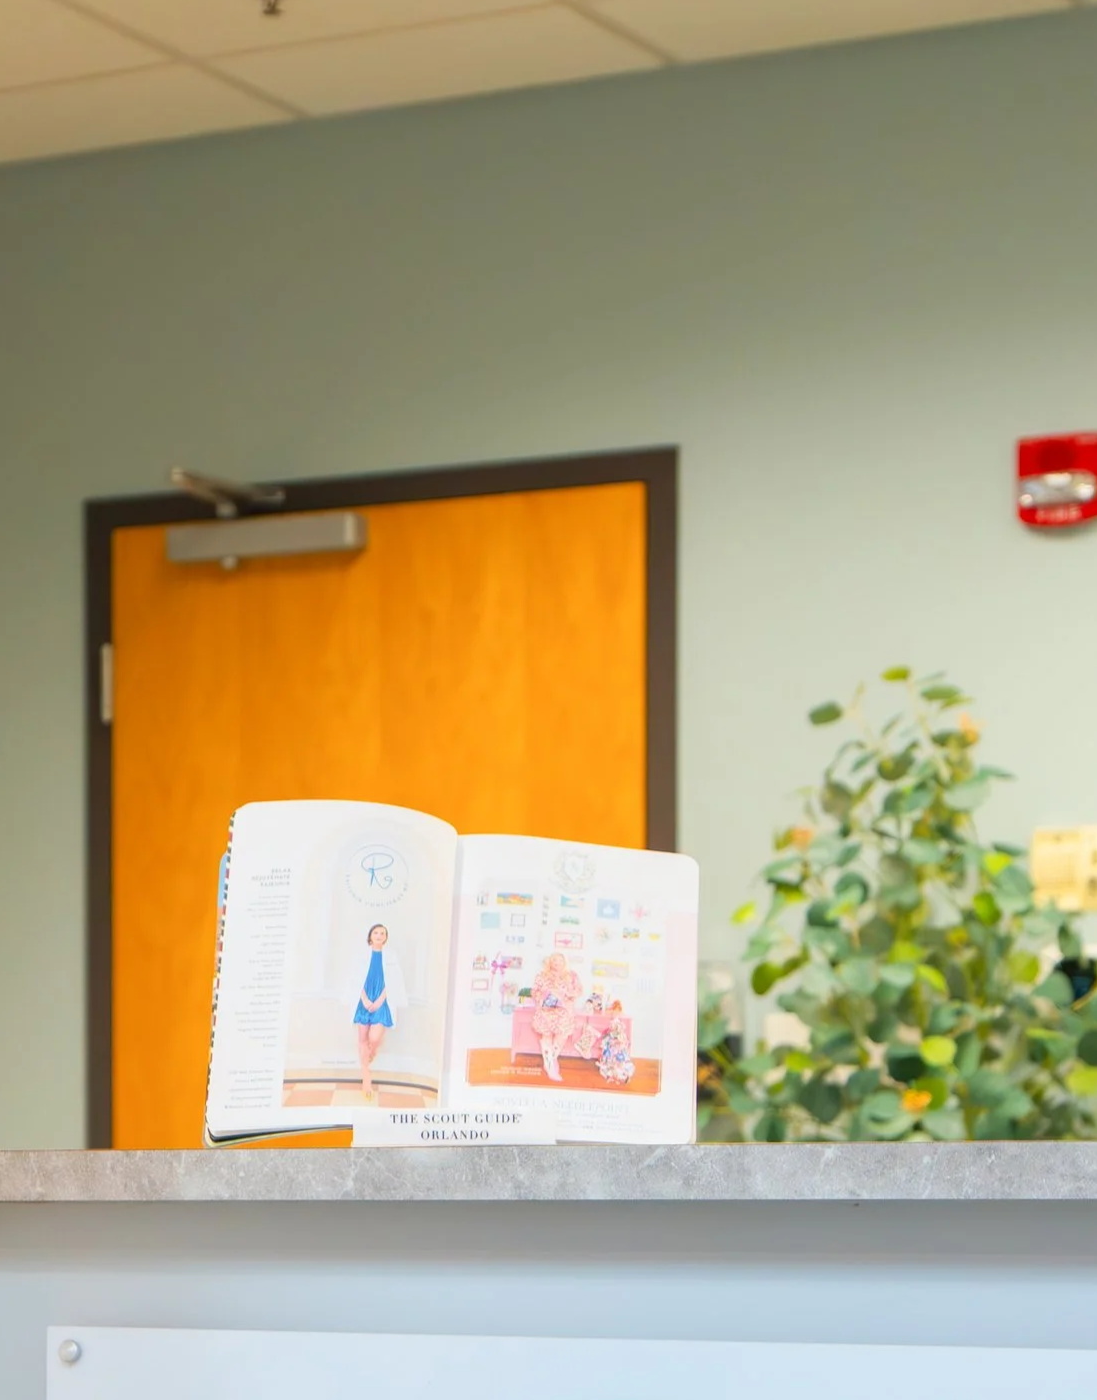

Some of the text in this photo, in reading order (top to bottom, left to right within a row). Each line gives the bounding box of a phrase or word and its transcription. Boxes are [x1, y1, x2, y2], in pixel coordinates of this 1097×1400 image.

[389, 1113, 418, 1124] THE
[423, 1113, 470, 1124] SCOUT
[420, 1129, 489, 1140] ORLANDO
